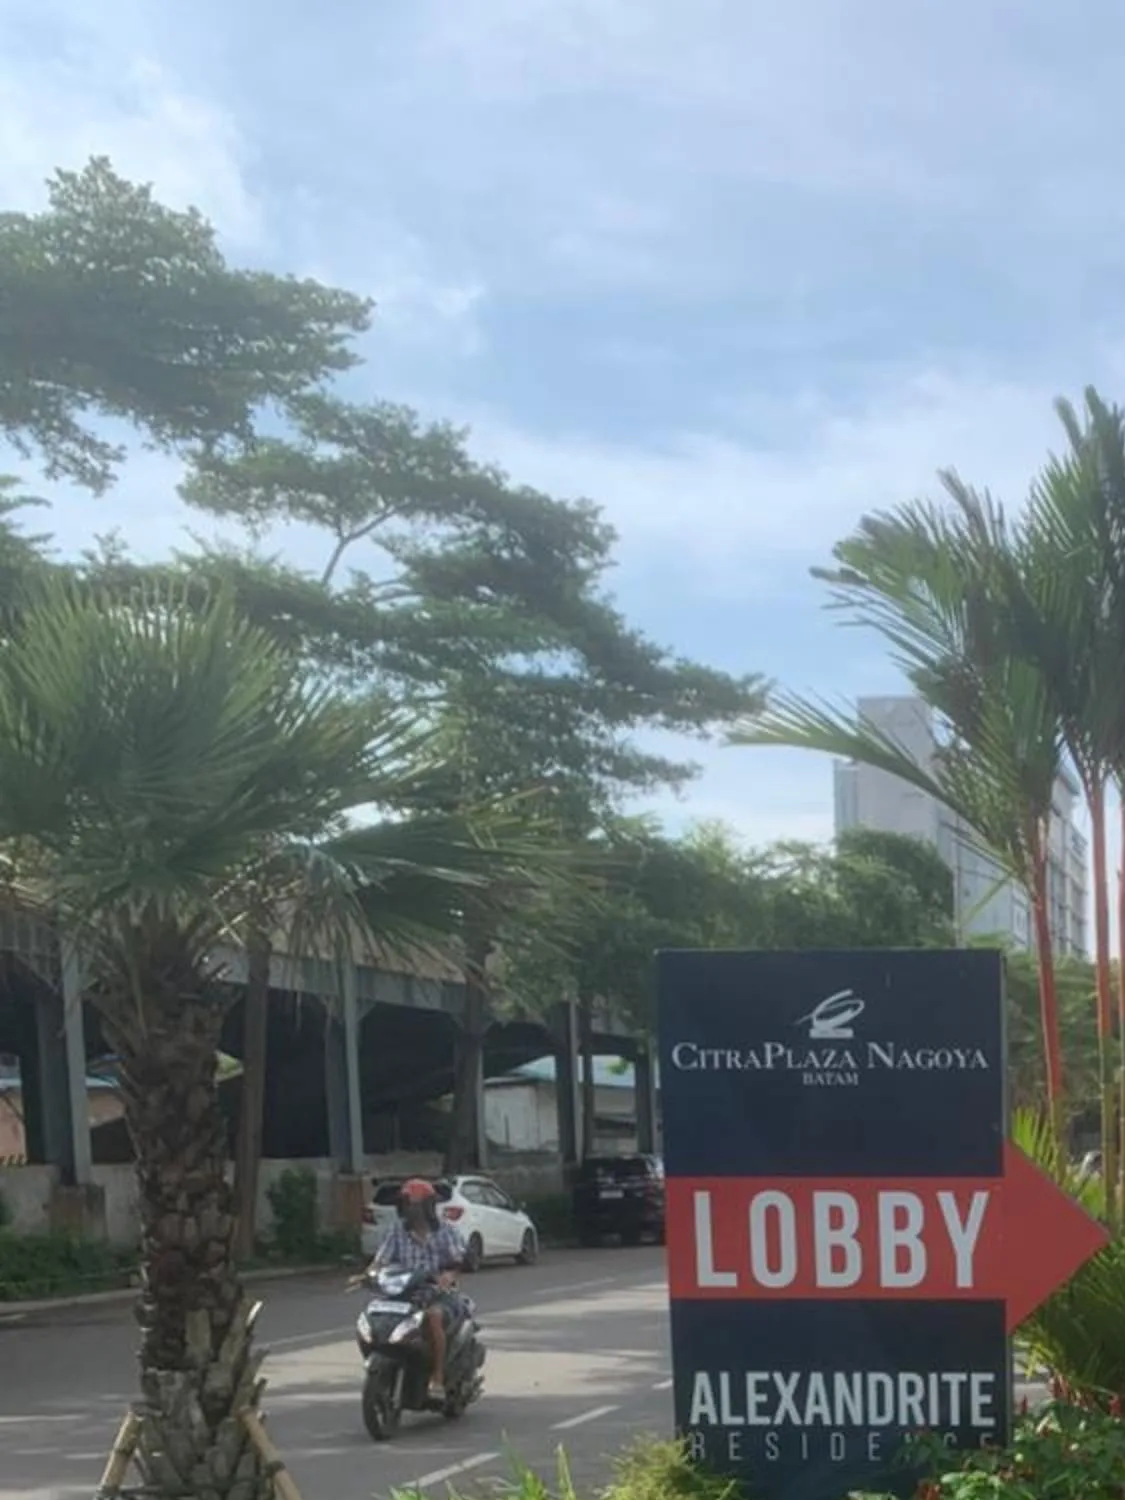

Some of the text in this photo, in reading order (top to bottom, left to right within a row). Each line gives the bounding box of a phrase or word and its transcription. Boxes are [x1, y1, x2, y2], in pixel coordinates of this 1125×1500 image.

[803, 1072, 859, 1086] BATAM
[694, 1191, 989, 1288] LOBBY
[690, 1371, 996, 1427] ALEXANDRITE
[690, 1431, 995, 1462] RESIDE
